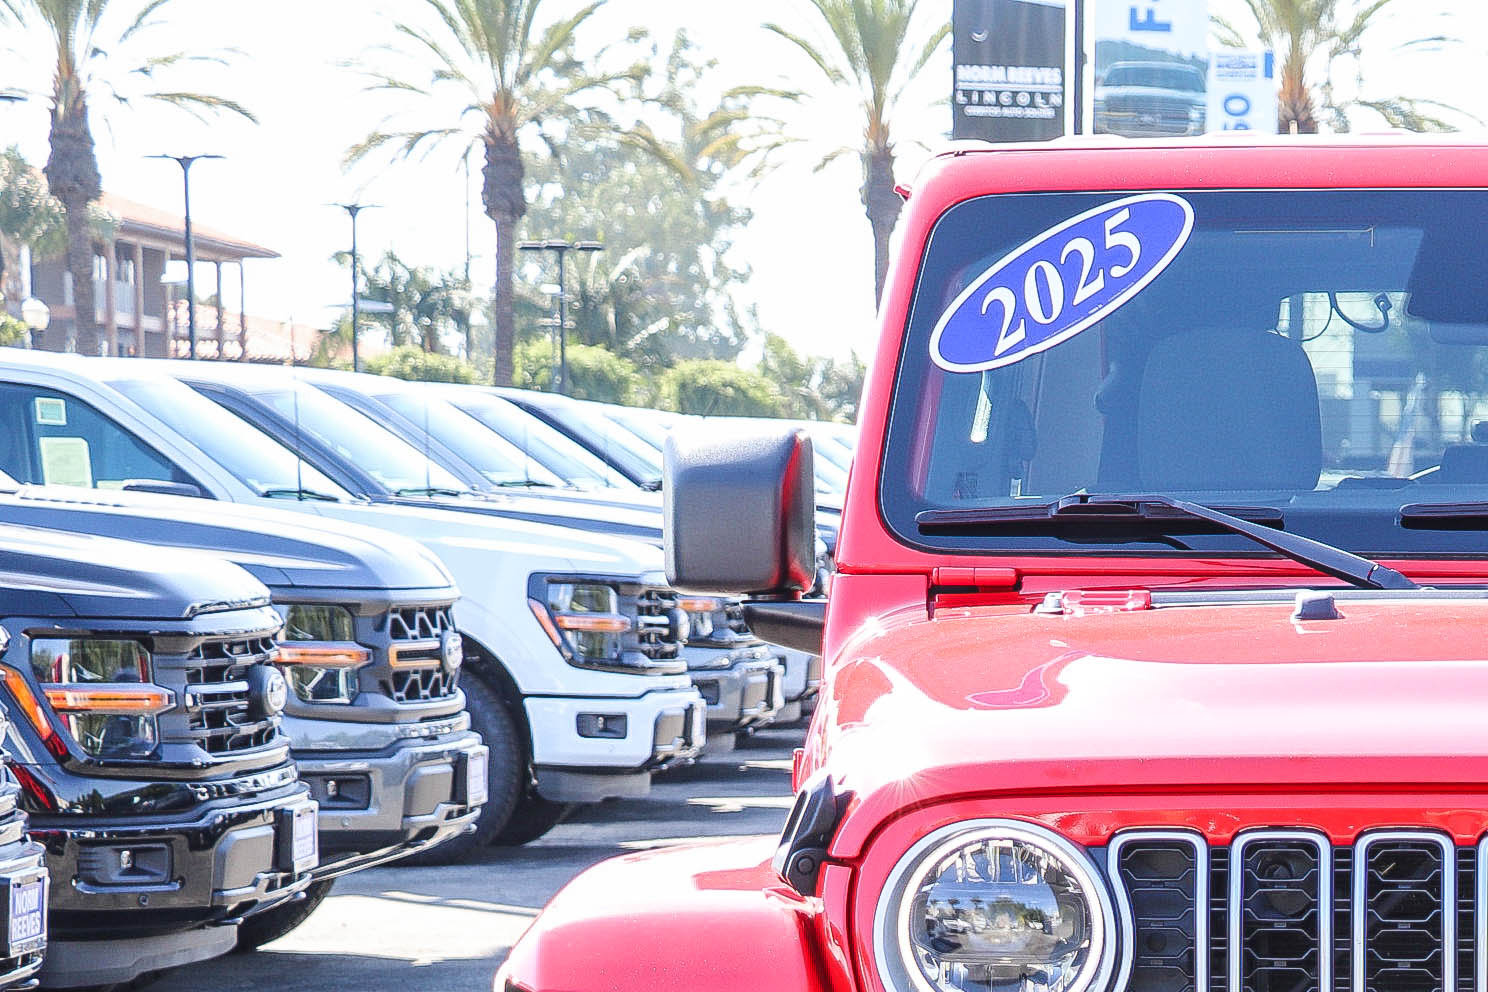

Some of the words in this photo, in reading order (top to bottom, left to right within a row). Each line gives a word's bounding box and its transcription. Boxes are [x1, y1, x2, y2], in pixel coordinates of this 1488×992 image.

[1129, 0, 1171, 32] F
[956, 90, 1062, 107] LINCOLN
[980, 207, 1142, 357] 2025
